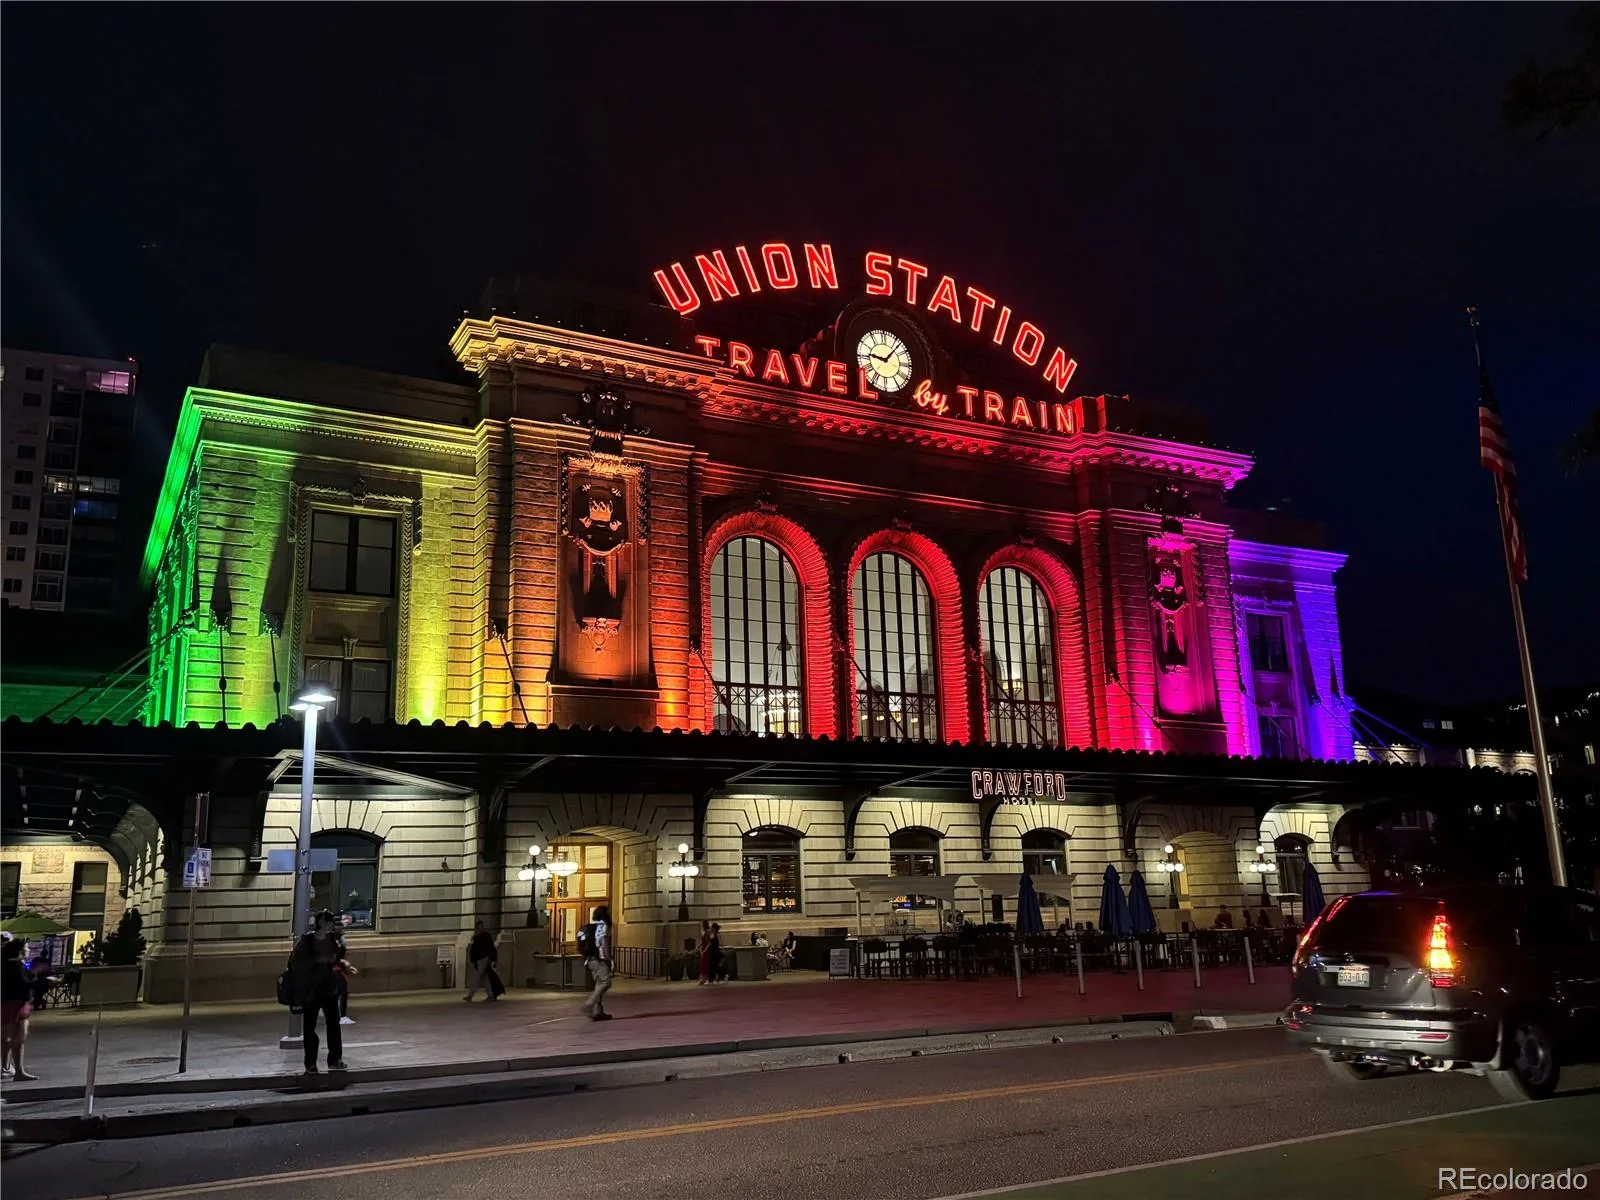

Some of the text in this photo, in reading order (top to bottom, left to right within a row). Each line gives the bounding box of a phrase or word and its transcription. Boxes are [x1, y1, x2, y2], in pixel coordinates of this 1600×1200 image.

[653, 243, 1078, 393] UNION STATION
[695, 334, 1075, 435] TRAVEL by TRAIN
[971, 770, 1066, 801] CRAWFORD
